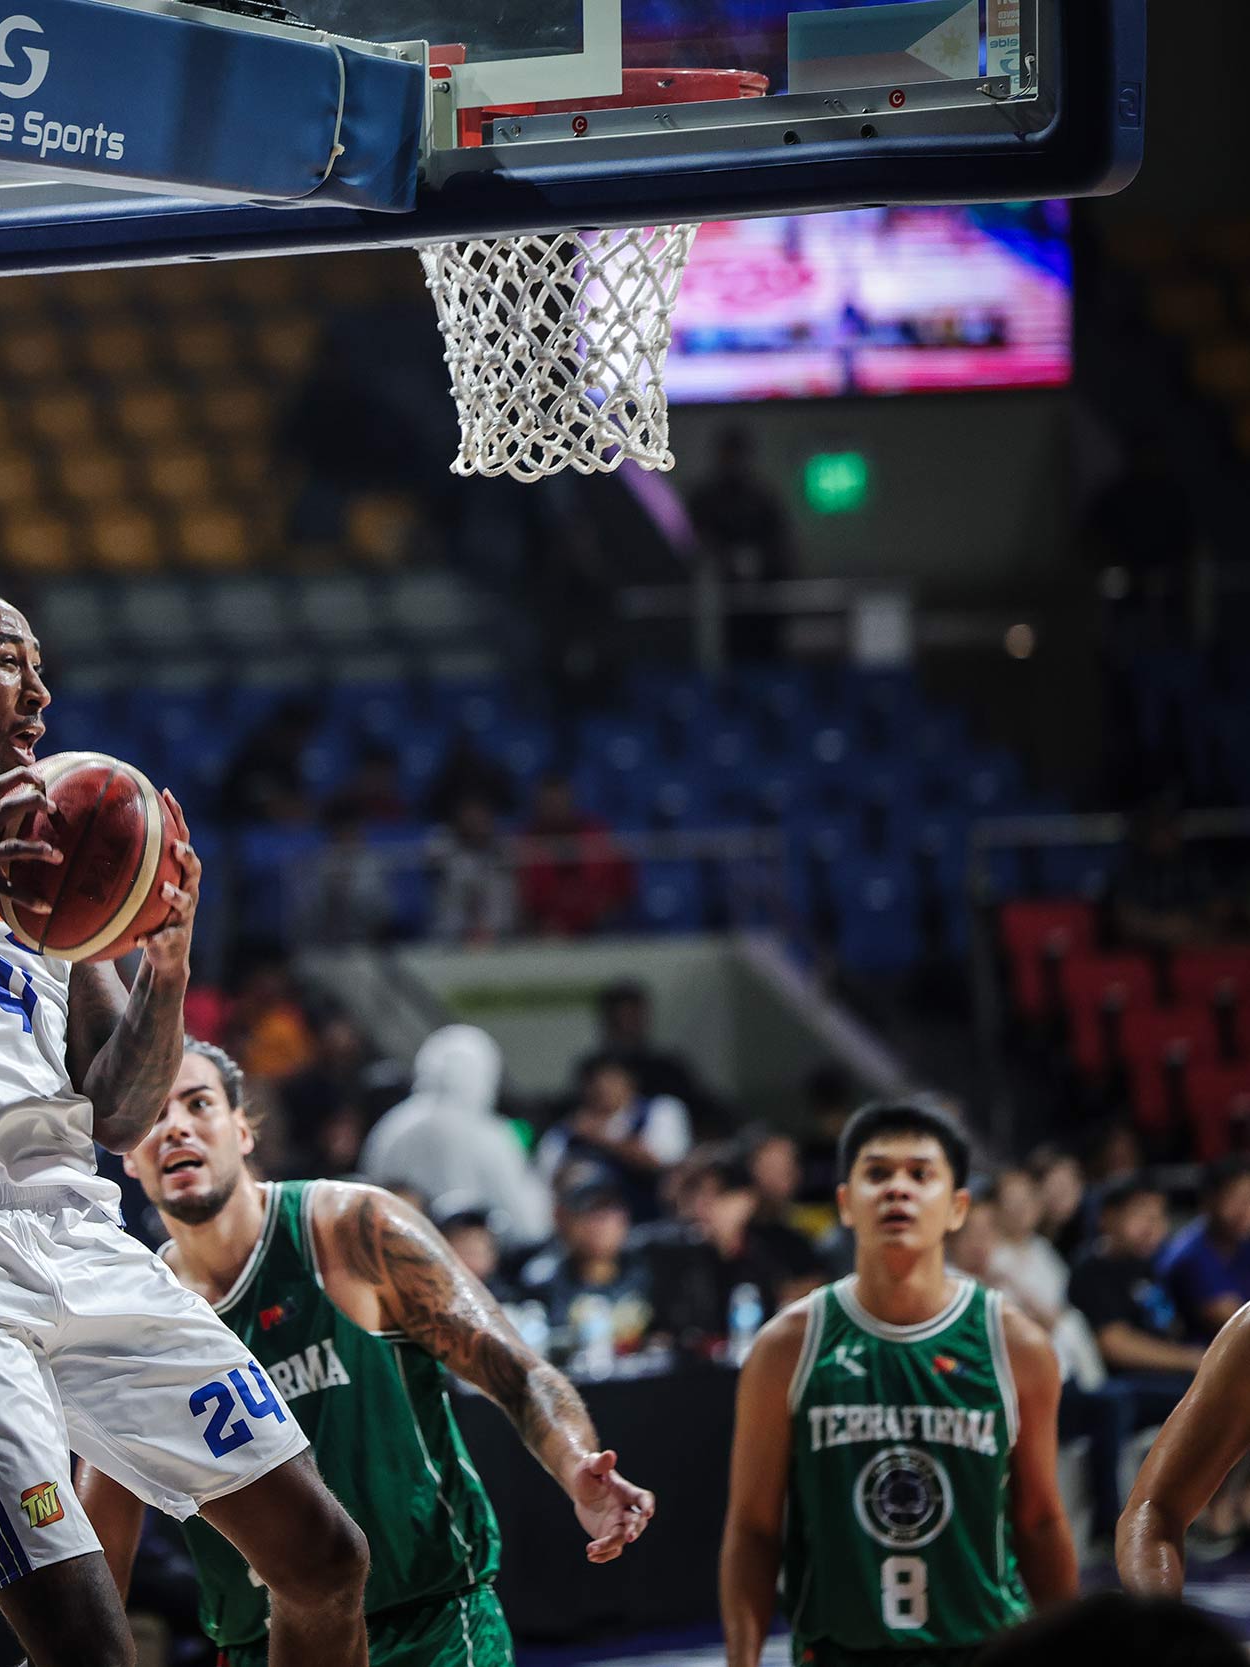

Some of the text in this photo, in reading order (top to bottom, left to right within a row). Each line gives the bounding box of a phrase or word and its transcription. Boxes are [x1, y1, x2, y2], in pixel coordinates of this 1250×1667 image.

[21, 110, 125, 161] Sports
[189, 1360, 287, 1459] 24
[807, 1403, 999, 1457] TERRAFIRMA
[21, 1481, 59, 1529] TNT
[880, 1555, 929, 1630] 8
